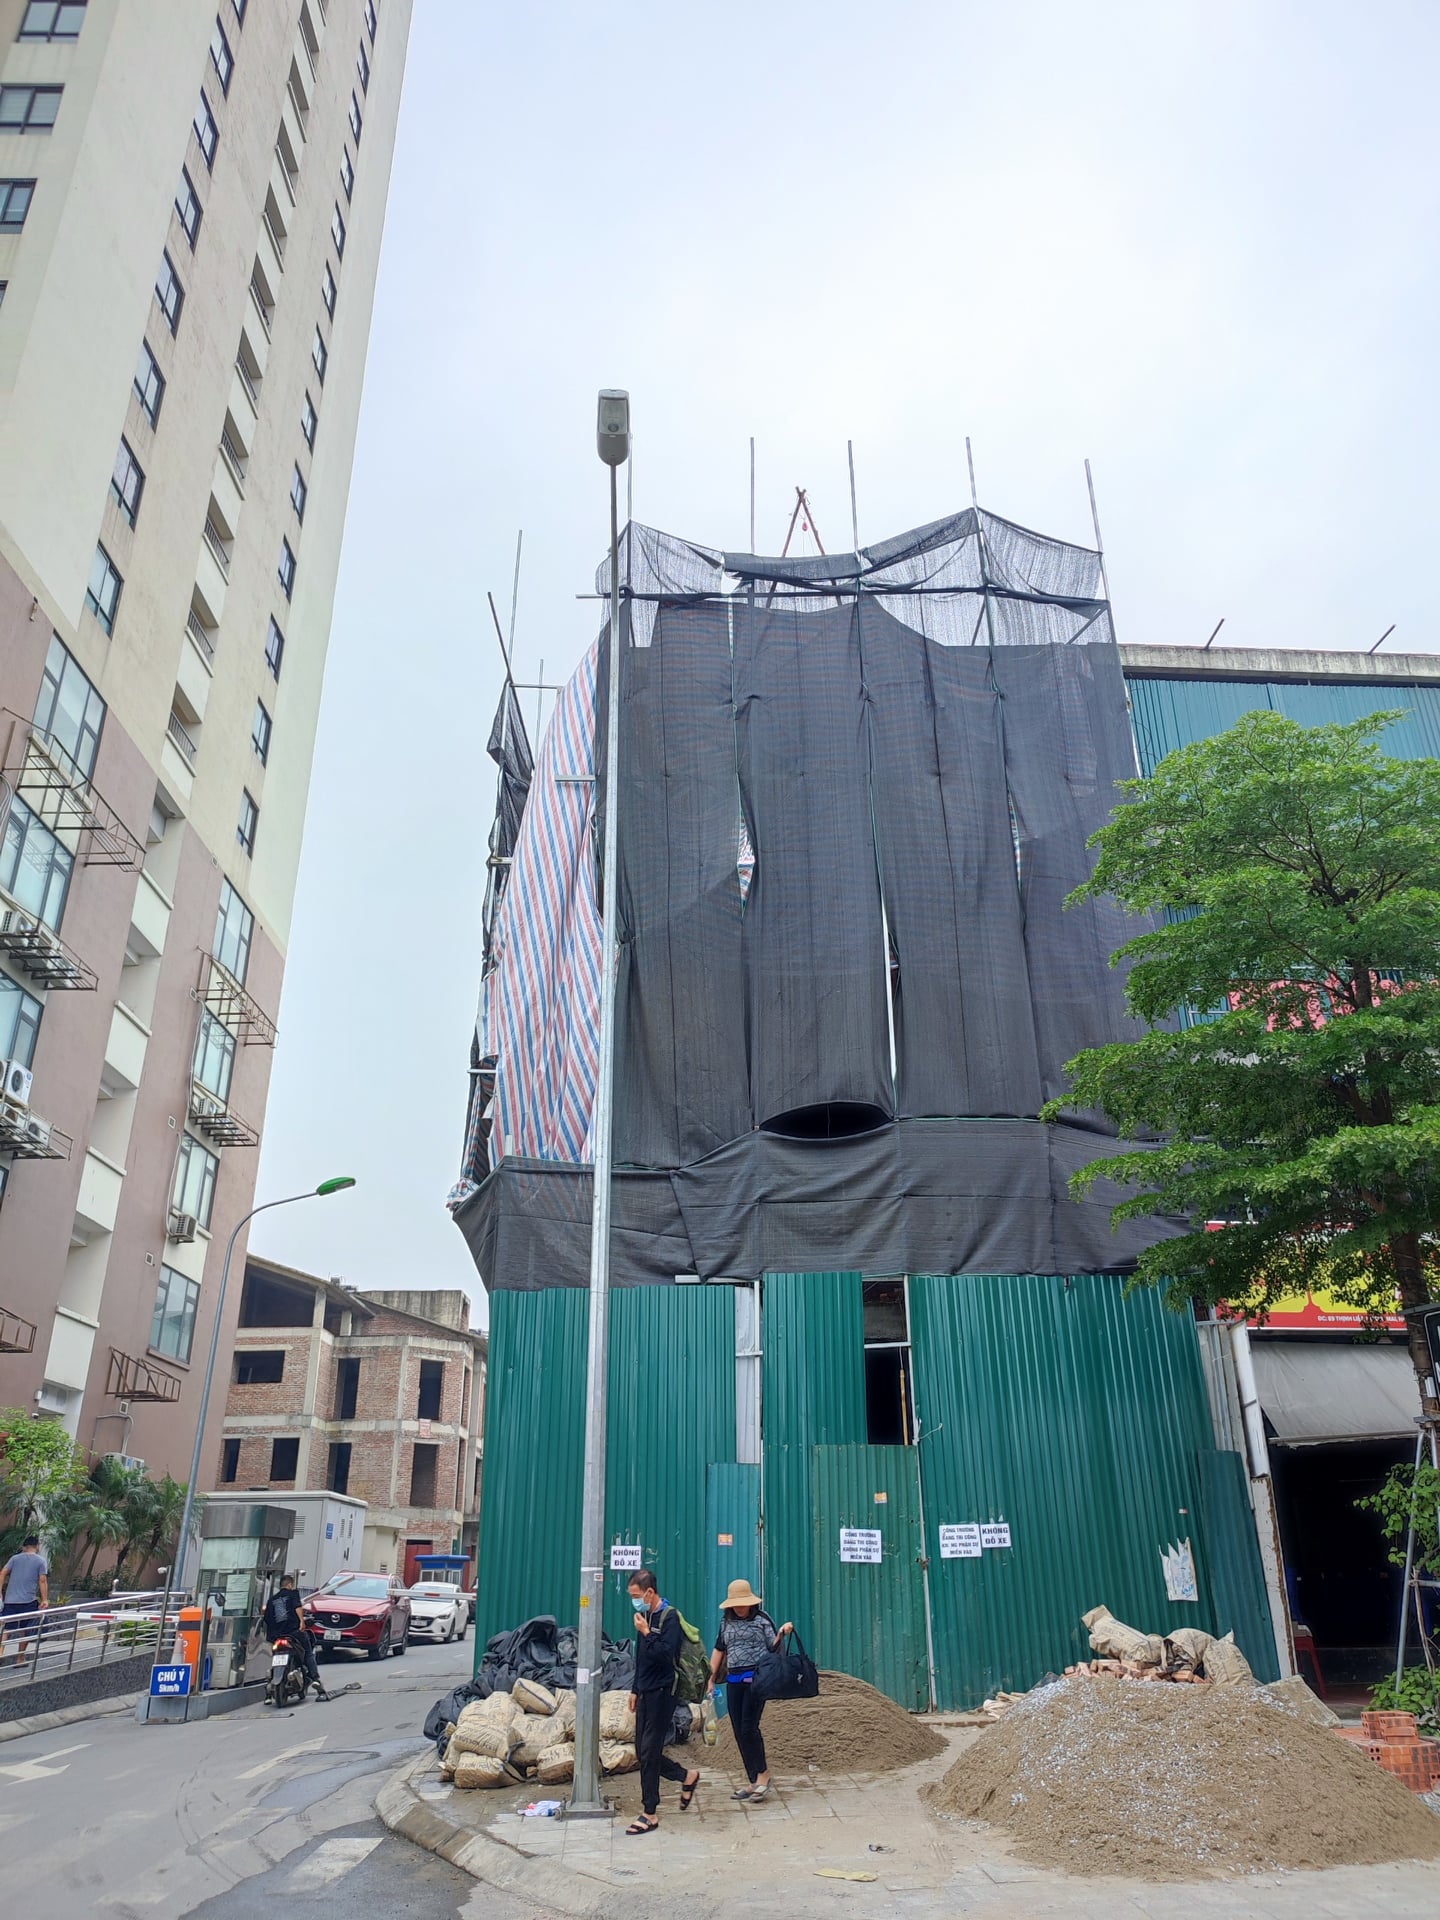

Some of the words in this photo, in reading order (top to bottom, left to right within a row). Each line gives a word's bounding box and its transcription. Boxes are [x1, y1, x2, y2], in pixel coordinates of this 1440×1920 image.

[982, 1526, 1008, 1534] KHÔNG
[158, 1668, 177, 1682] CHÚ
[178, 1668, 185, 1682] Ý
